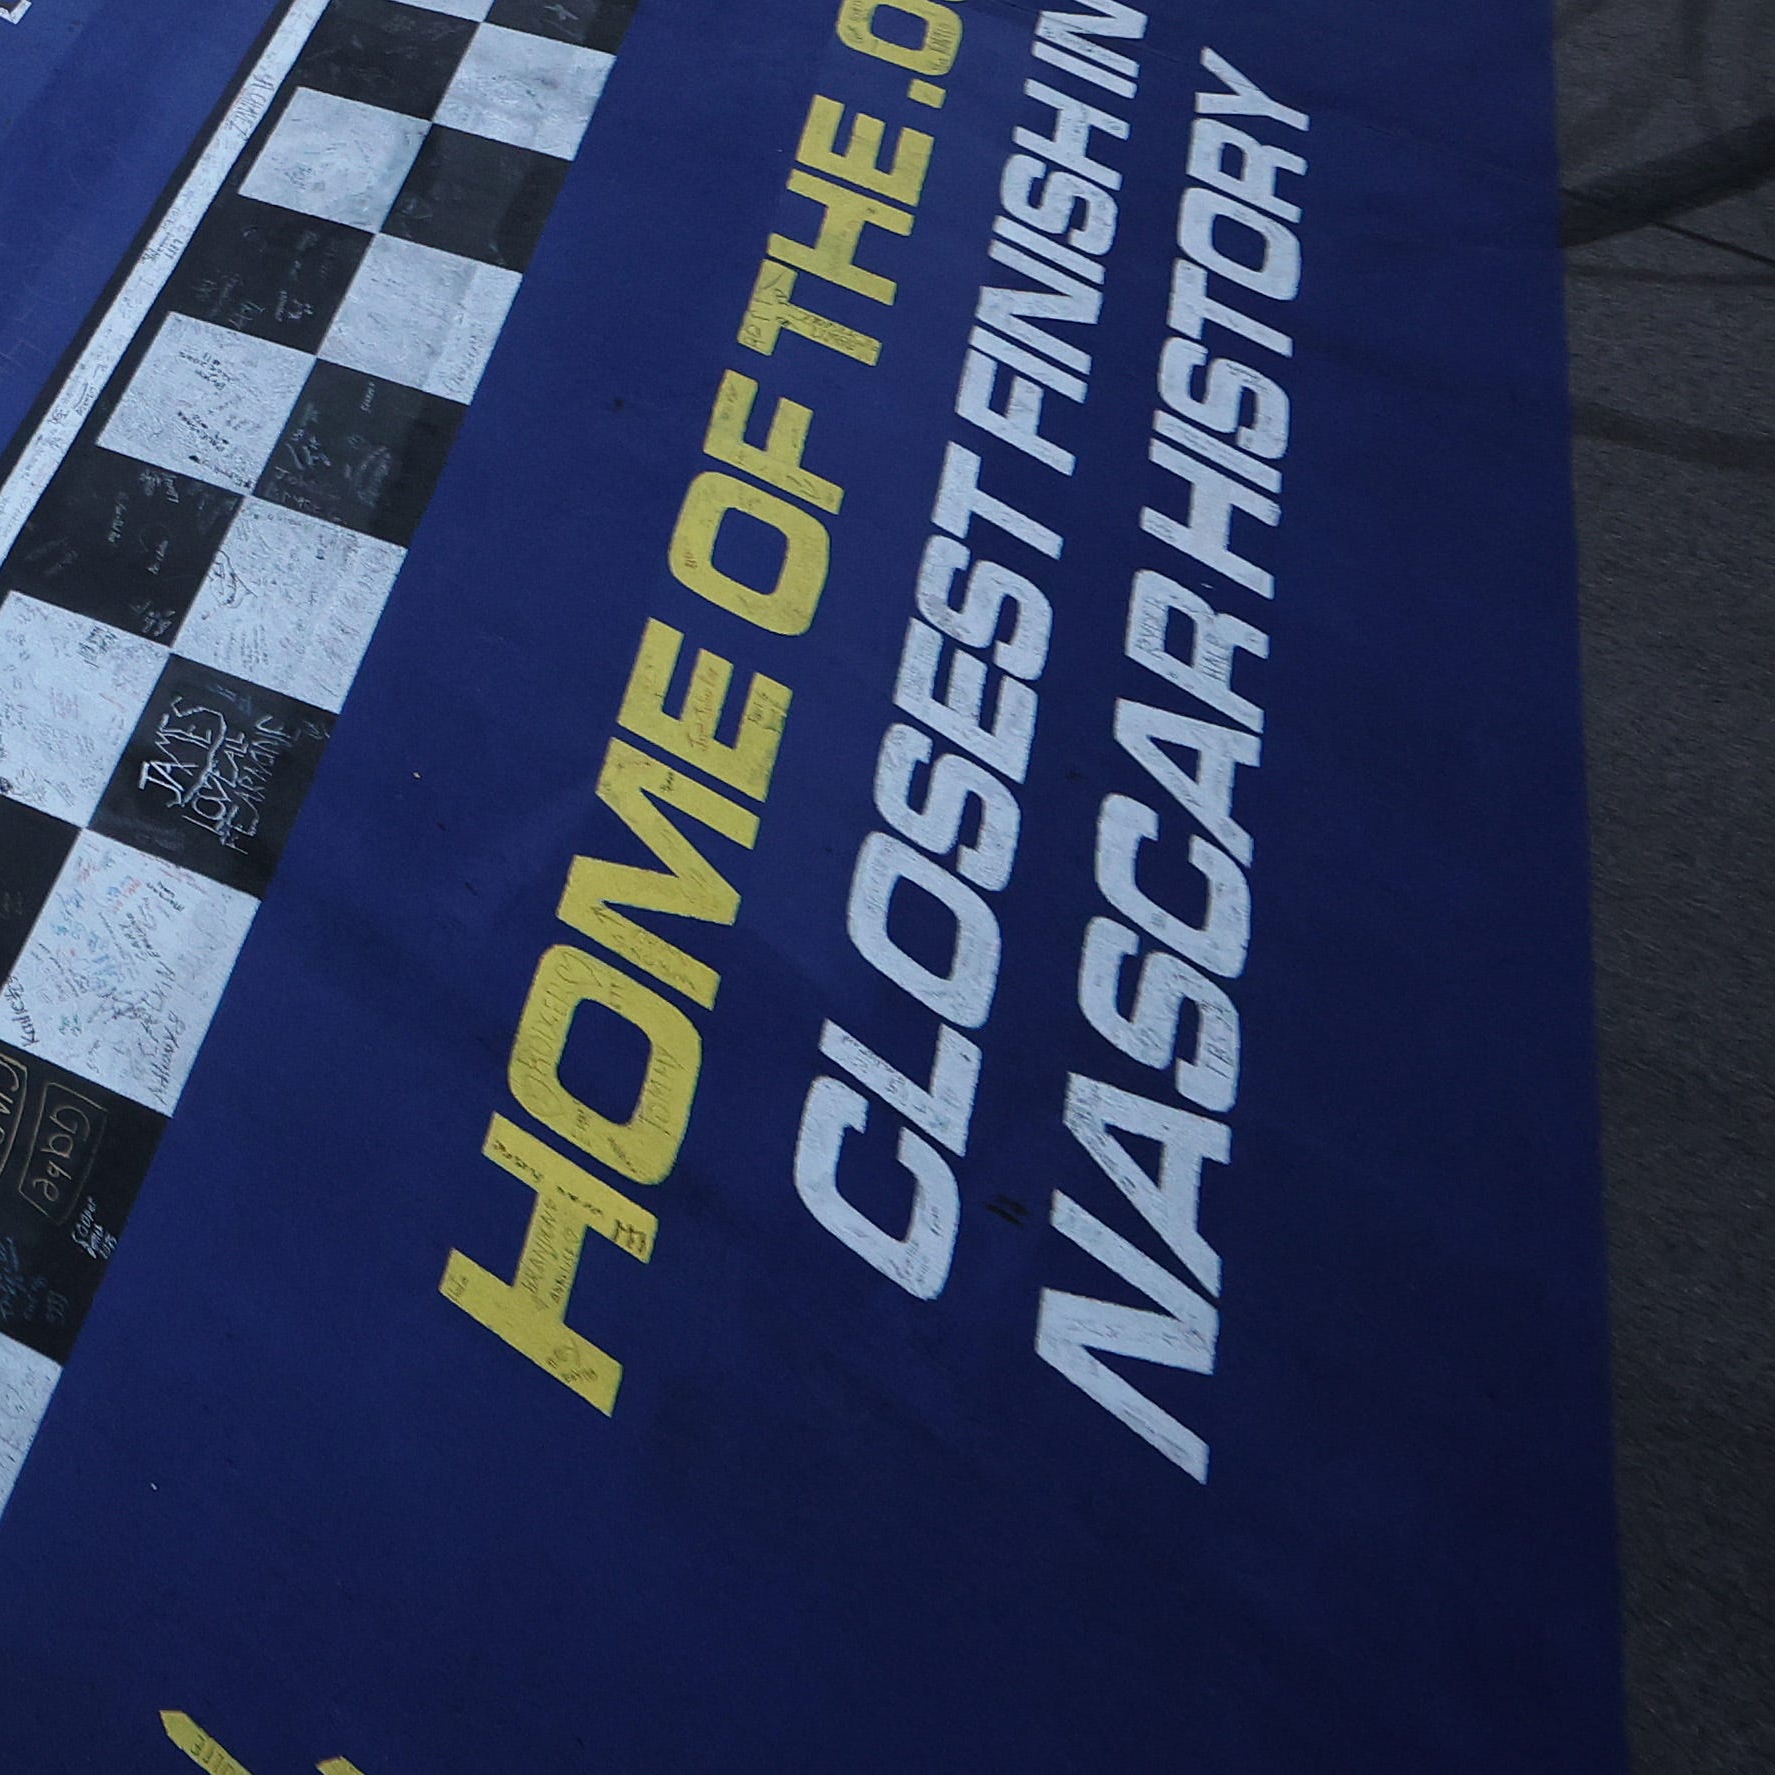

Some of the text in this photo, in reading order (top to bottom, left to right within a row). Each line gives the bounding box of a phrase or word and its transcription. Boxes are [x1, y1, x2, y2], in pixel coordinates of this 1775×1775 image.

[737, 94, 933, 367] THE
[137, 695, 227, 809] JAMES
[668, 371, 844, 636] OF
[793, 440, 1064, 1300] CLOSEST
[955, 77, 1141, 477] FINISH
[1035, 47, 1310, 1484] NASCAR HISTORY
[439, 618, 794, 1418] HOME
